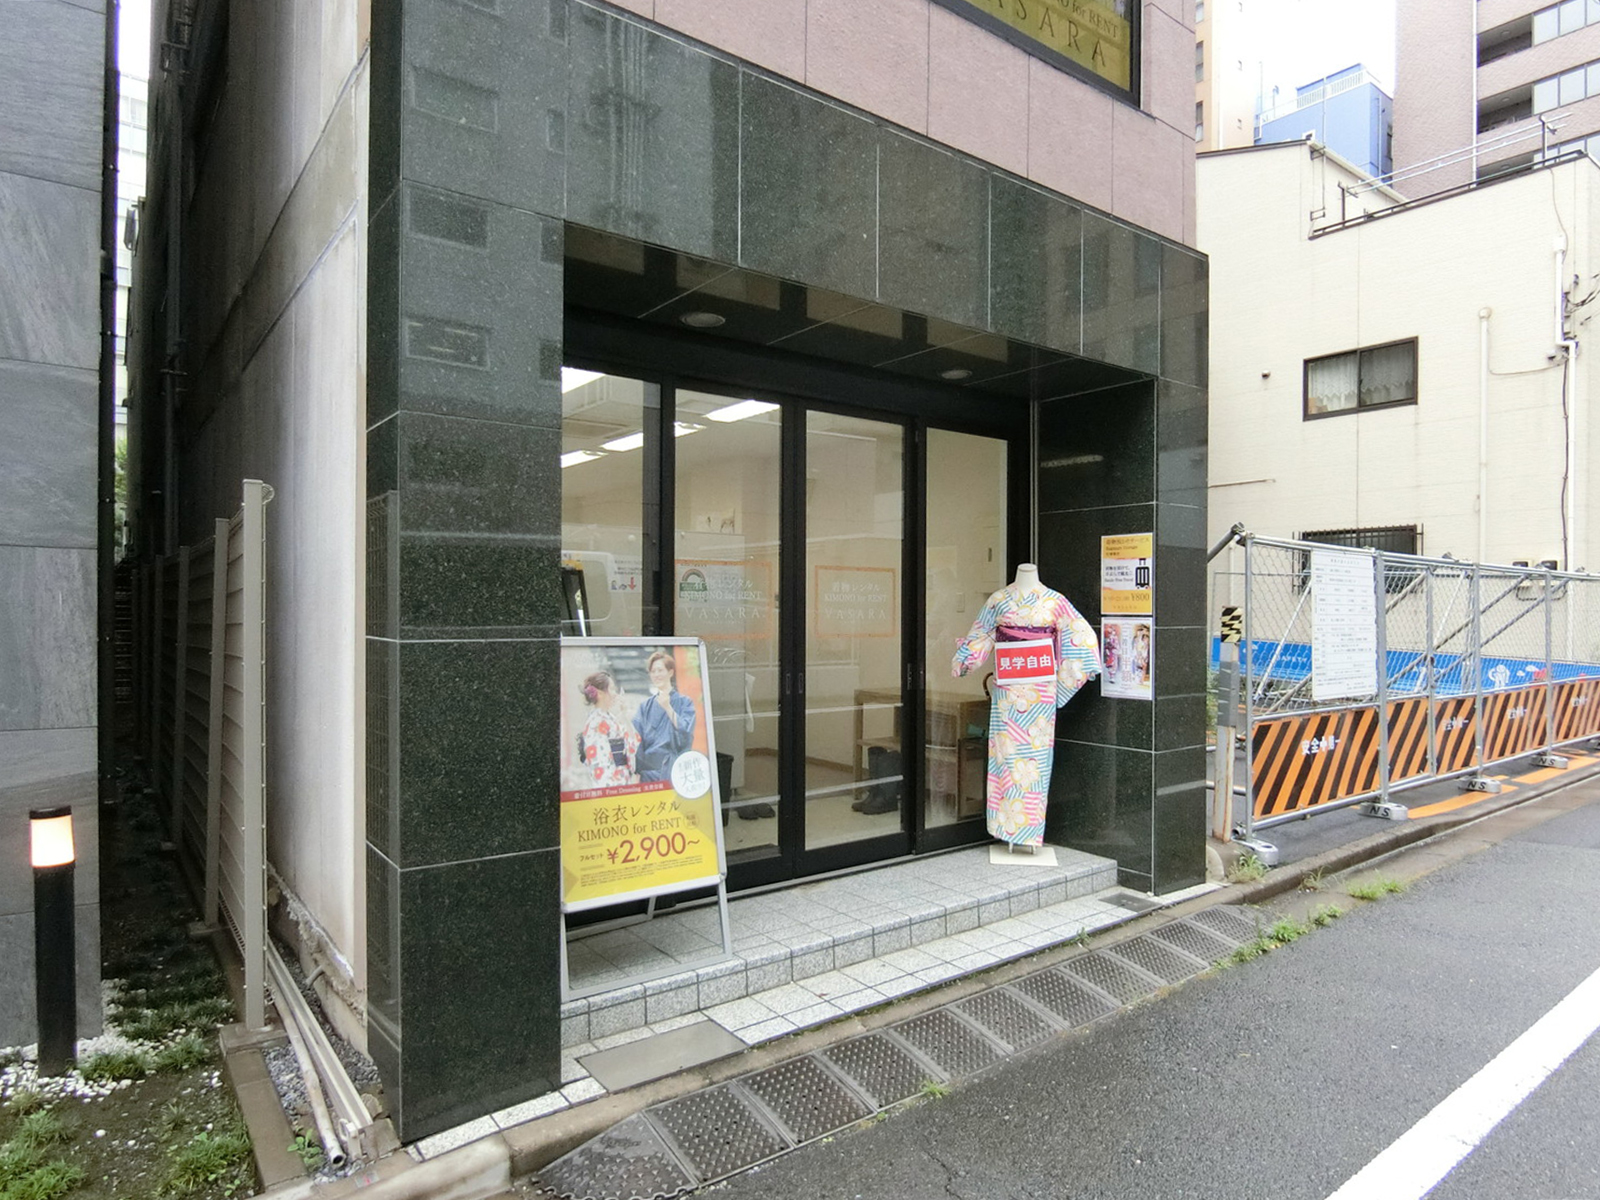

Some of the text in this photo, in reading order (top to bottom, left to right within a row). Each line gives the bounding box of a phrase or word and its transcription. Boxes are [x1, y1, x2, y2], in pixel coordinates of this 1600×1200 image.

[1088, 10, 1118, 38] RENT
[738, 590, 763, 600] RENT
[684, 607, 762, 619] VASARA
[824, 608, 886, 620] VASARA
[1000, 654, 1052, 671] 見学自由
[593, 801, 681, 825] 浴衣レンタル
[578, 825, 629, 842] KIMONO
[633, 823, 648, 834] for
[651, 817, 682, 832] RENT
[579, 852, 604, 862] フルセット
